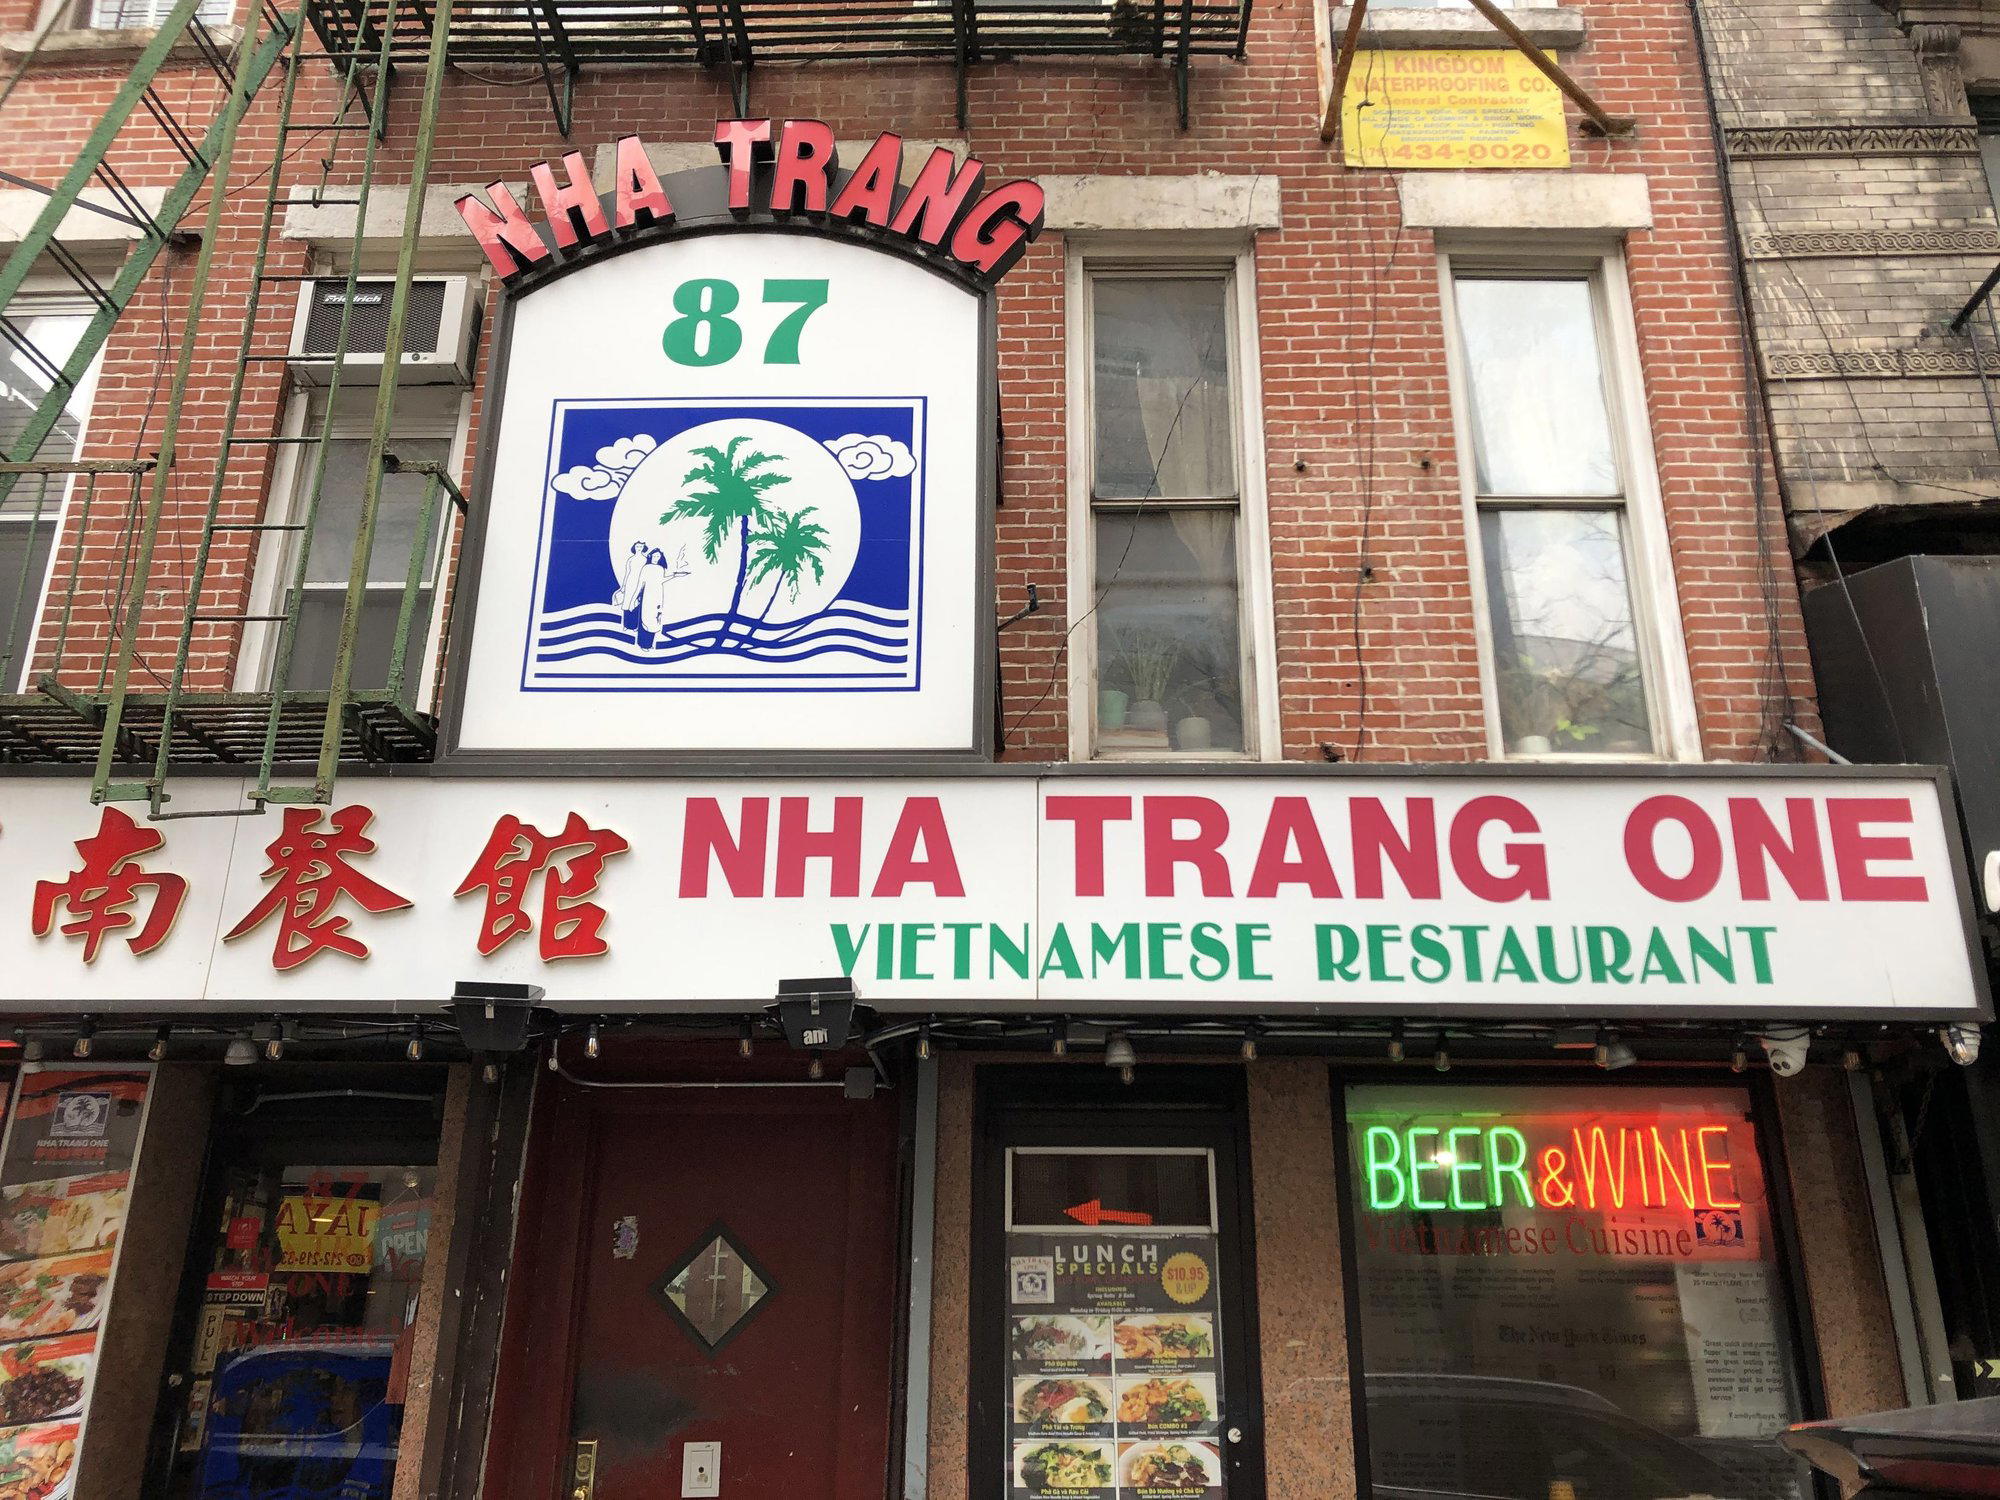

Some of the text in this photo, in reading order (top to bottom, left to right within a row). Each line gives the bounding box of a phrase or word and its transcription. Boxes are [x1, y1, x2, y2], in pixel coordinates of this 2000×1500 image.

[1394, 56, 1506, 75] KINGDOM
[1353, 77, 1551, 93] WATERPROOFING CO.
[1381, 96, 1530, 105] General Contractor
[454, 118, 1044, 281] NHA TRANG
[662, 278, 831, 368] 87
[678, 794, 1930, 903] NHA TRANG ONE
[829, 921, 1778, 985] VIETNAMESE RESTAURANT
[1364, 1125, 1535, 1211] BEER
[1572, 1125, 1742, 1210] WINE
[382, 1229, 429, 1258] OPEN
[1362, 1215, 1694, 1256] Vietnamese Cuisine
[1054, 1244, 1158, 1264] LUNCH
[1055, 1263, 1159, 1276] SPECIALS
[1167, 1266, 1204, 1282] $10.95
[206, 1292, 265, 1302] STEP DOWN
[1183, 1283, 1197, 1294] UP
